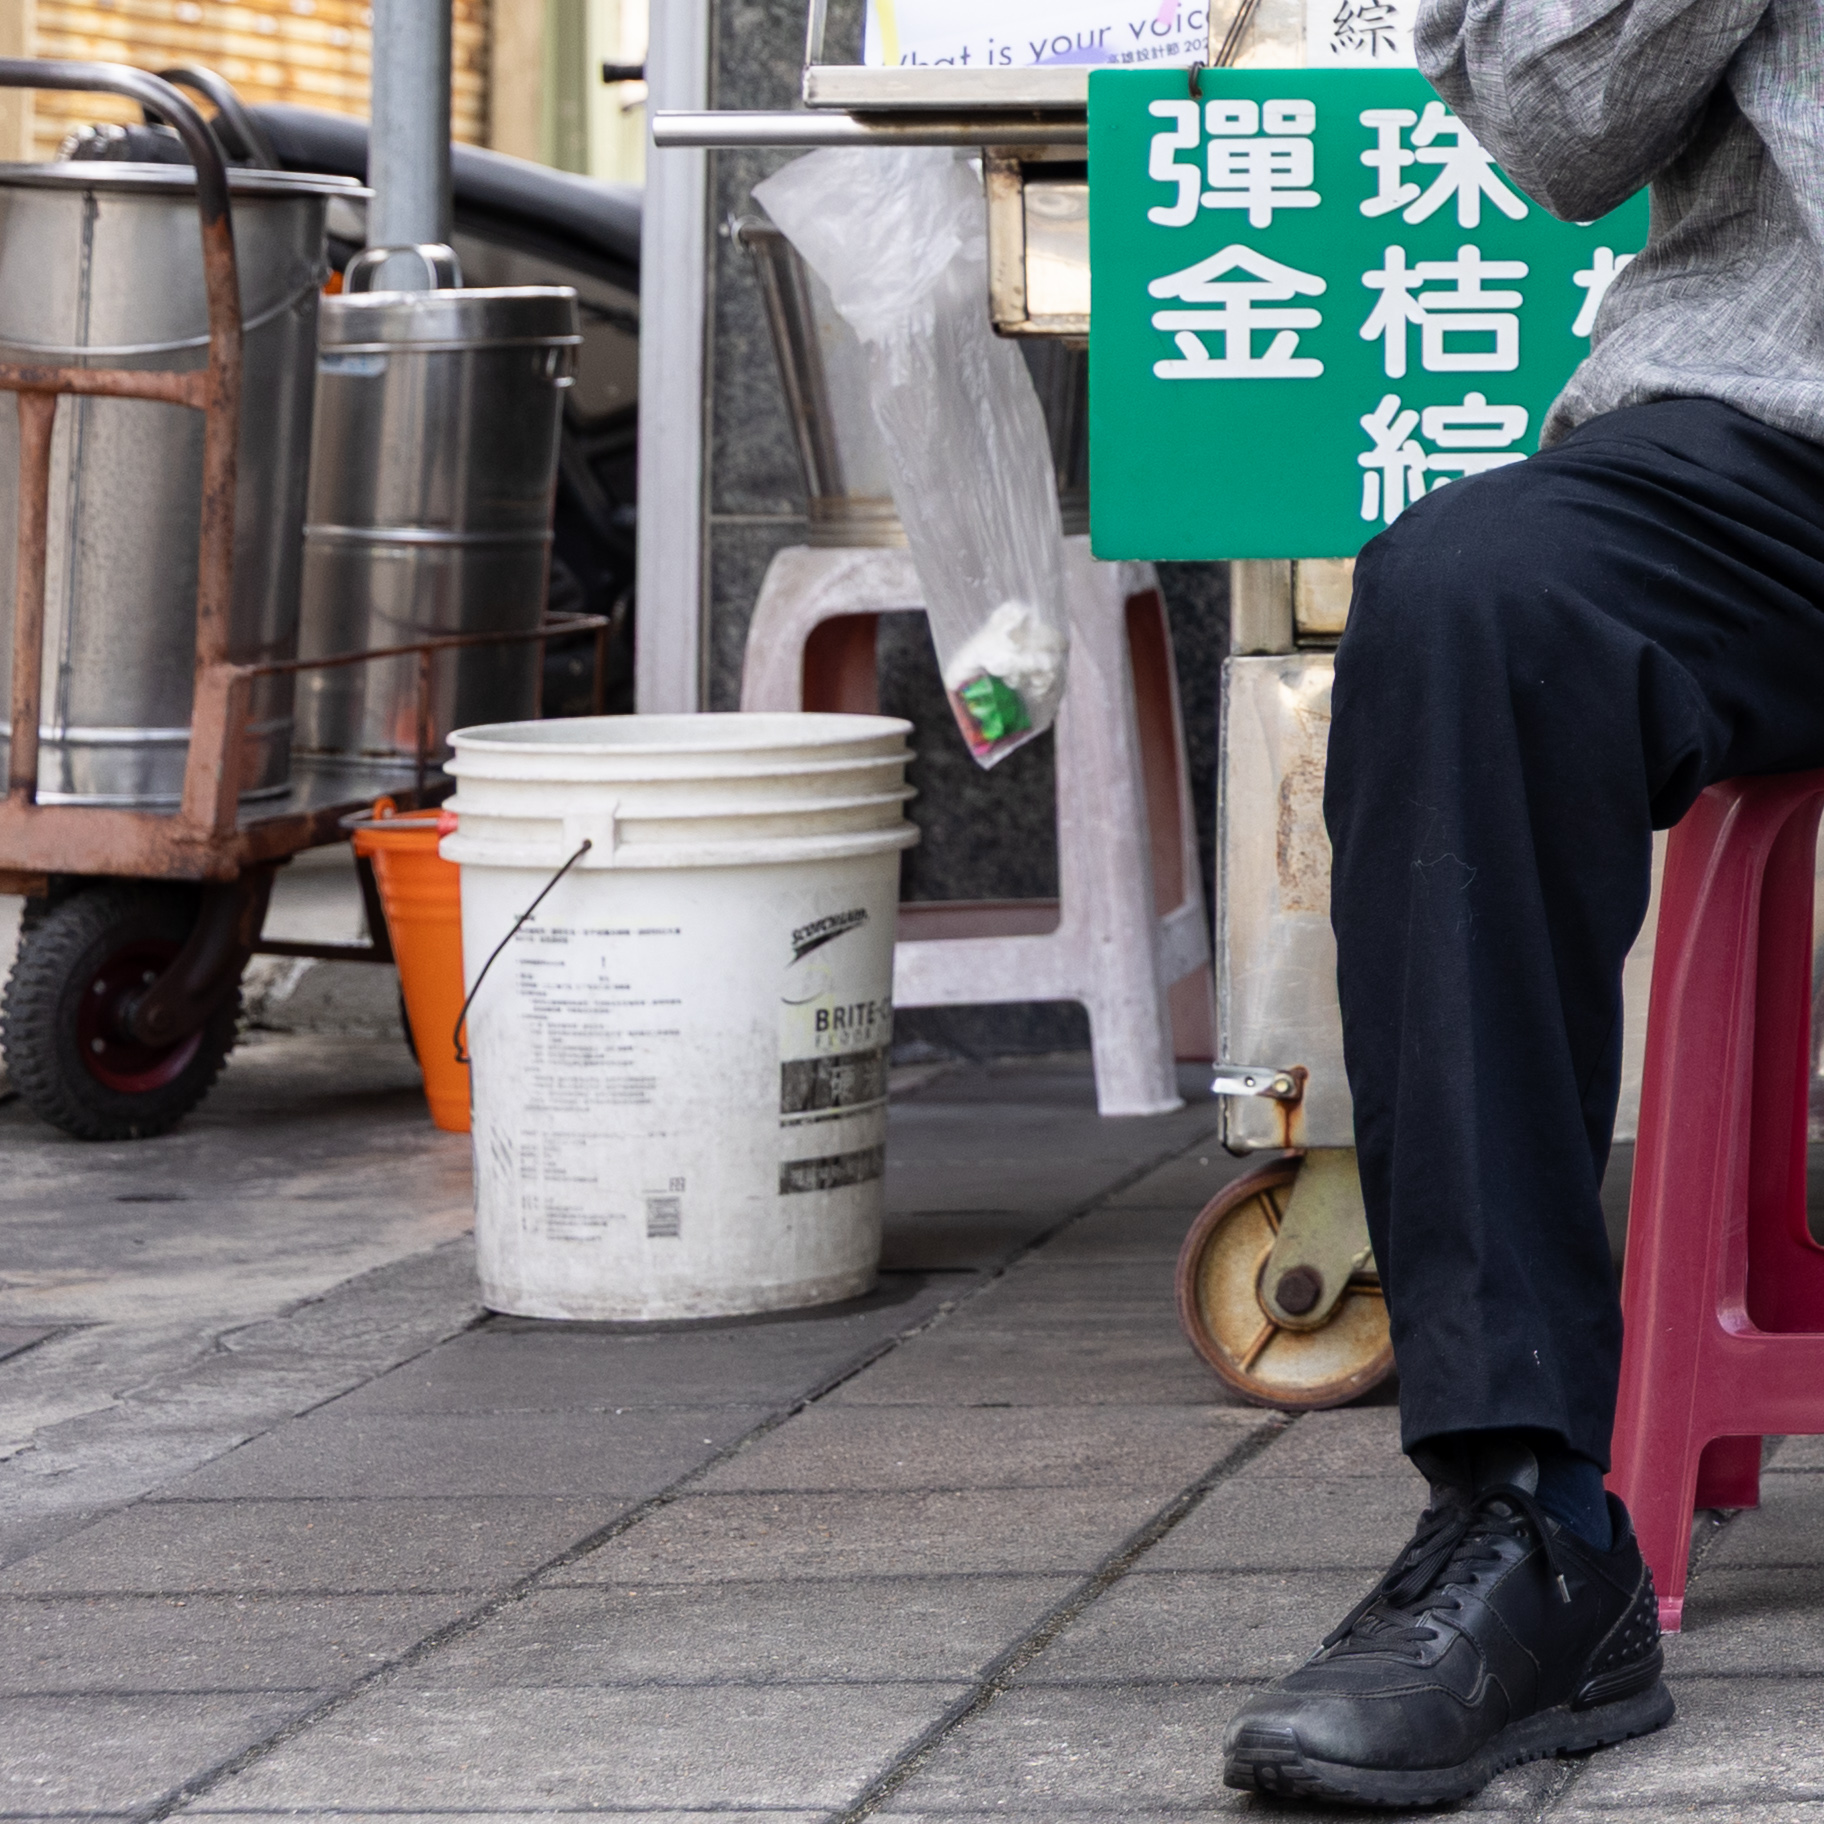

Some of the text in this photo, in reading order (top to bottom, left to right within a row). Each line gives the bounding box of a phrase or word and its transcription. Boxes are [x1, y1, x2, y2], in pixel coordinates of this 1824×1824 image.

[1029, 25, 1112, 64] your
[1128, 2, 1209, 41] voic
[1148, 99, 1528, 229] 彈珠
[1148, 244, 1634, 380] 金桔
